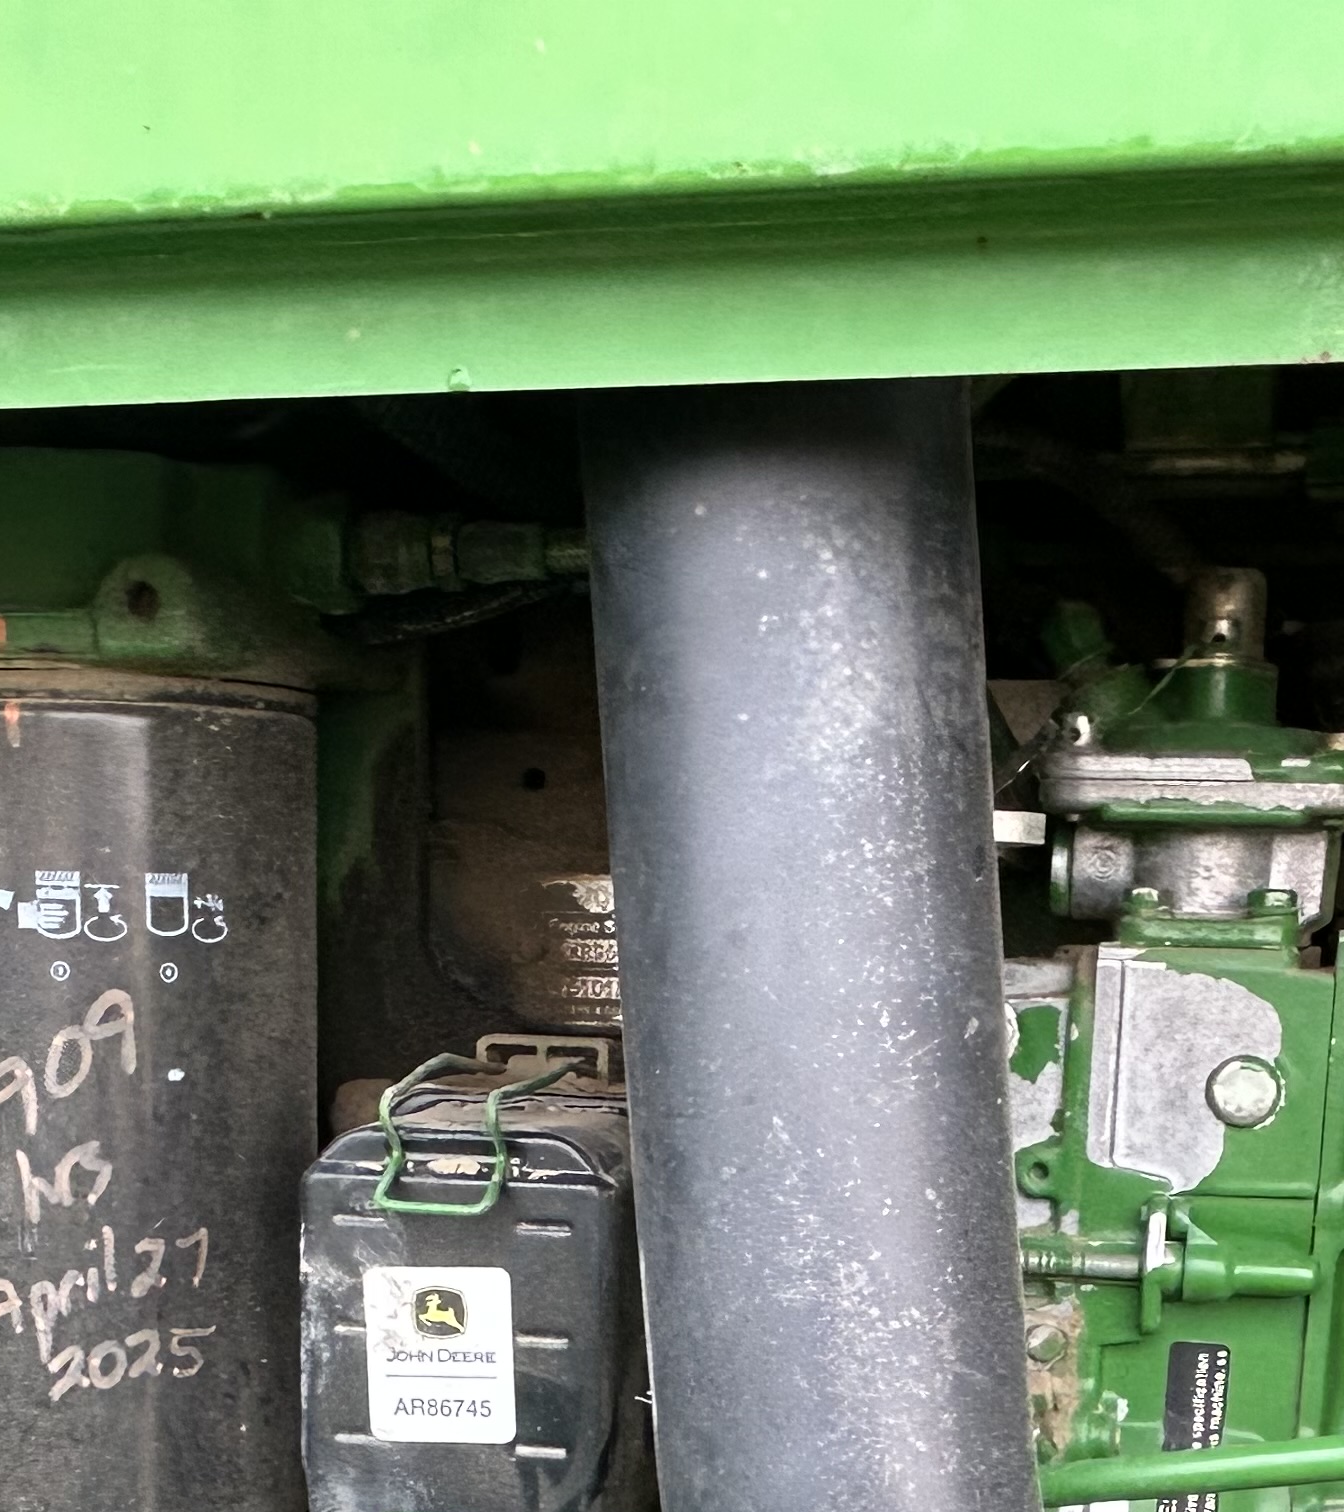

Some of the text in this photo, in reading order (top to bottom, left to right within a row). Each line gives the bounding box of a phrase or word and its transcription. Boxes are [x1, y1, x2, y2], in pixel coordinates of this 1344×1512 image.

[130, 1226, 209, 1298] 27
[48, 1326, 217, 1401] 2025
[386, 1347, 497, 1364] JOHN DEERE
[394, 1398, 492, 1418] AR86745
